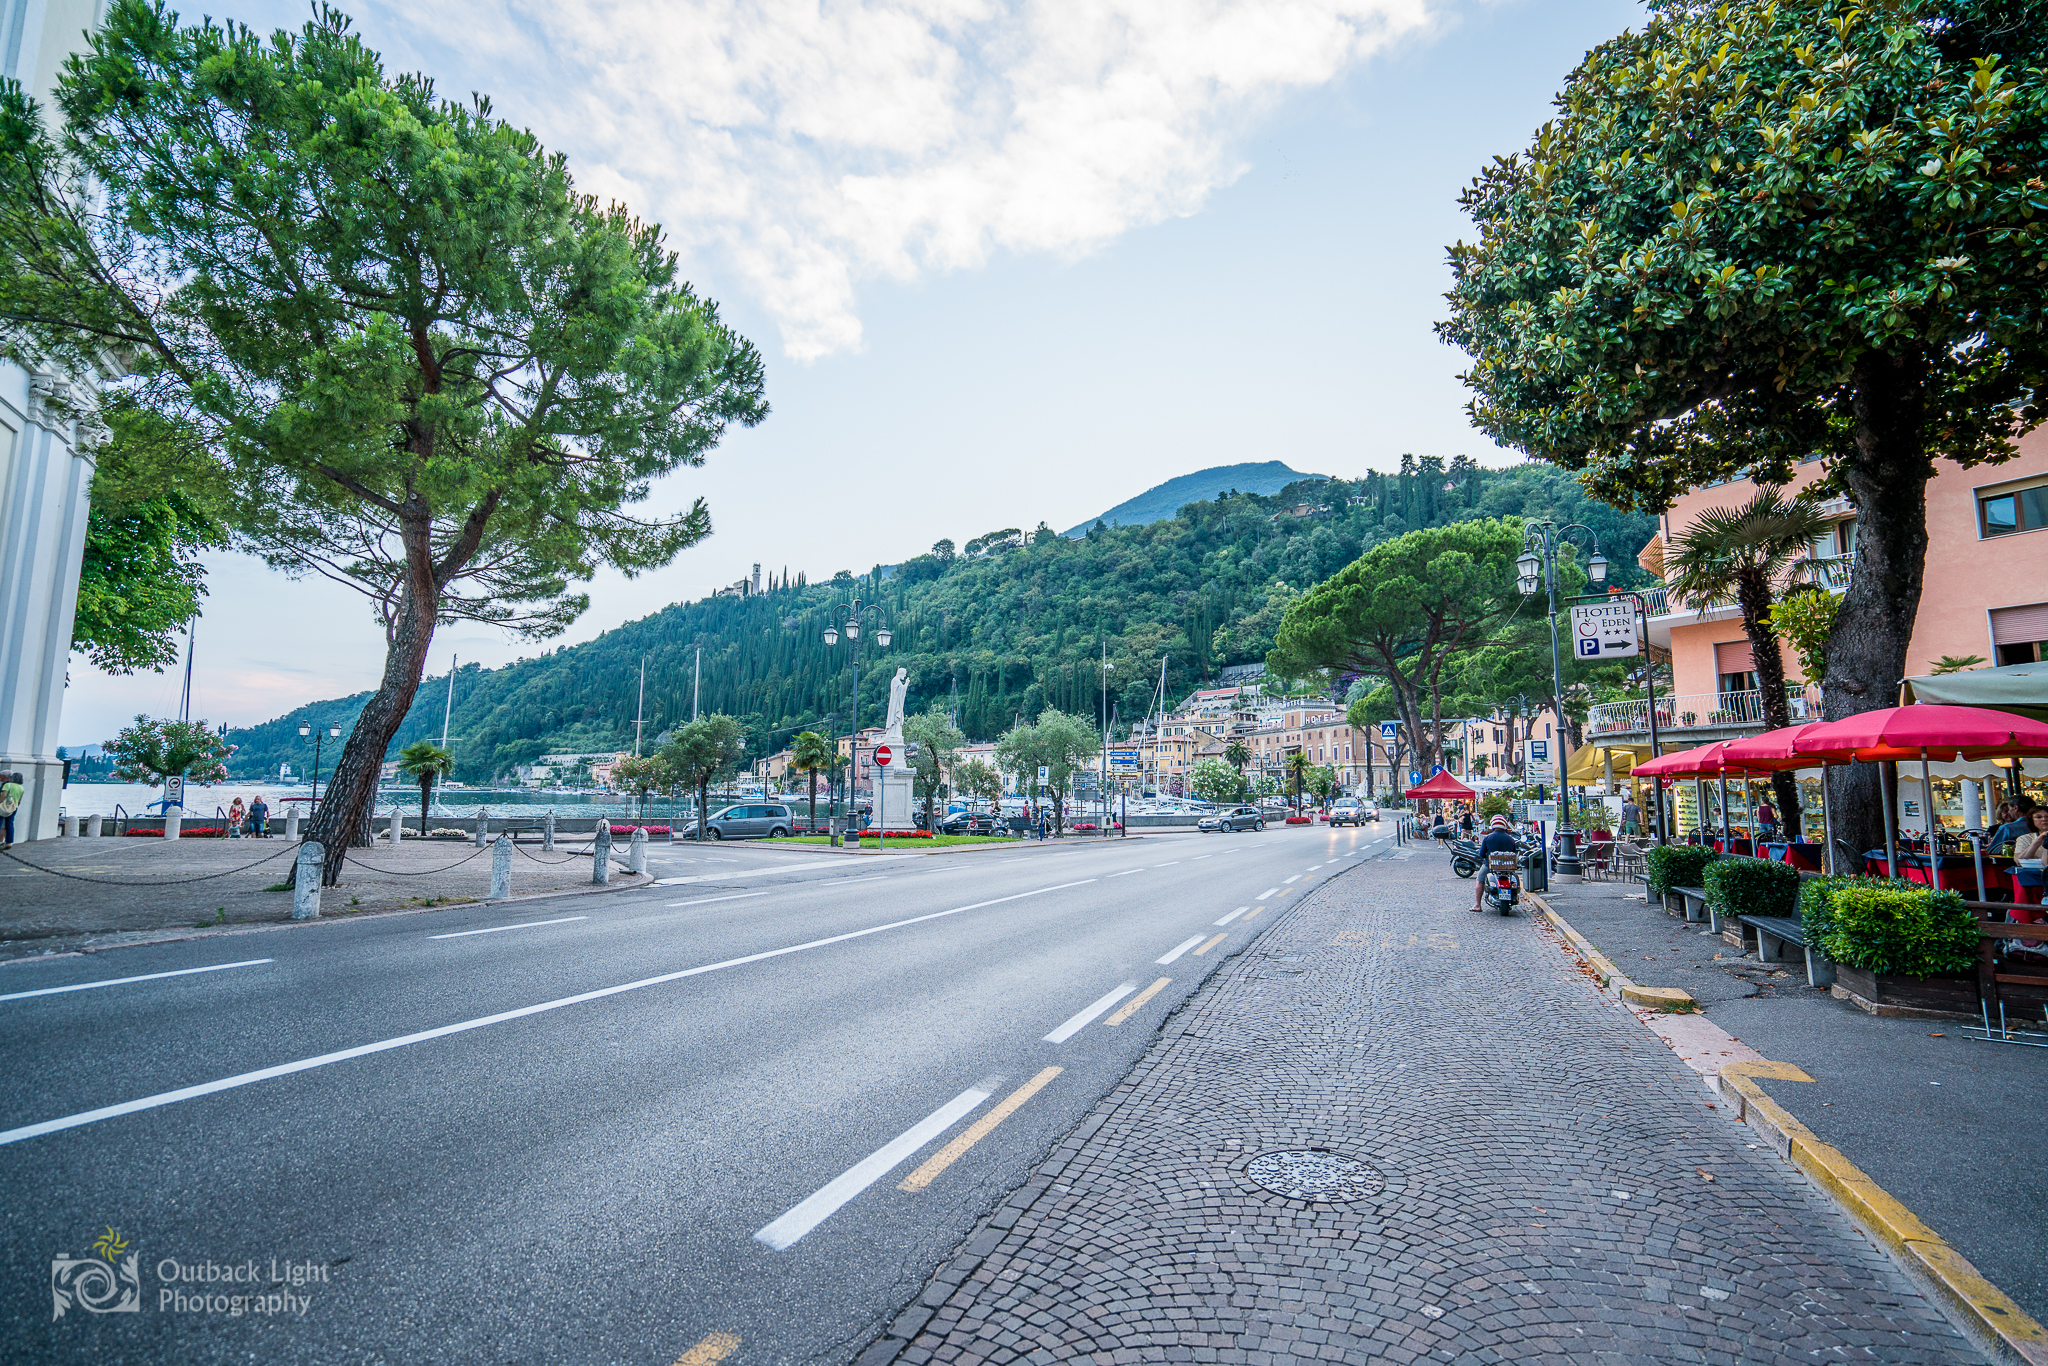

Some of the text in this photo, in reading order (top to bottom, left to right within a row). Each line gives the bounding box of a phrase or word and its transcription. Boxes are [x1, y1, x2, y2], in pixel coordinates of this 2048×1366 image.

[1576, 606, 1630, 618] HOTEL
[1602, 618, 1630, 627] EDEN
[1582, 639, 1596, 655] P
[1305, 713, 1335, 725] HOTEL
[1331, 930, 1459, 950] BUS
